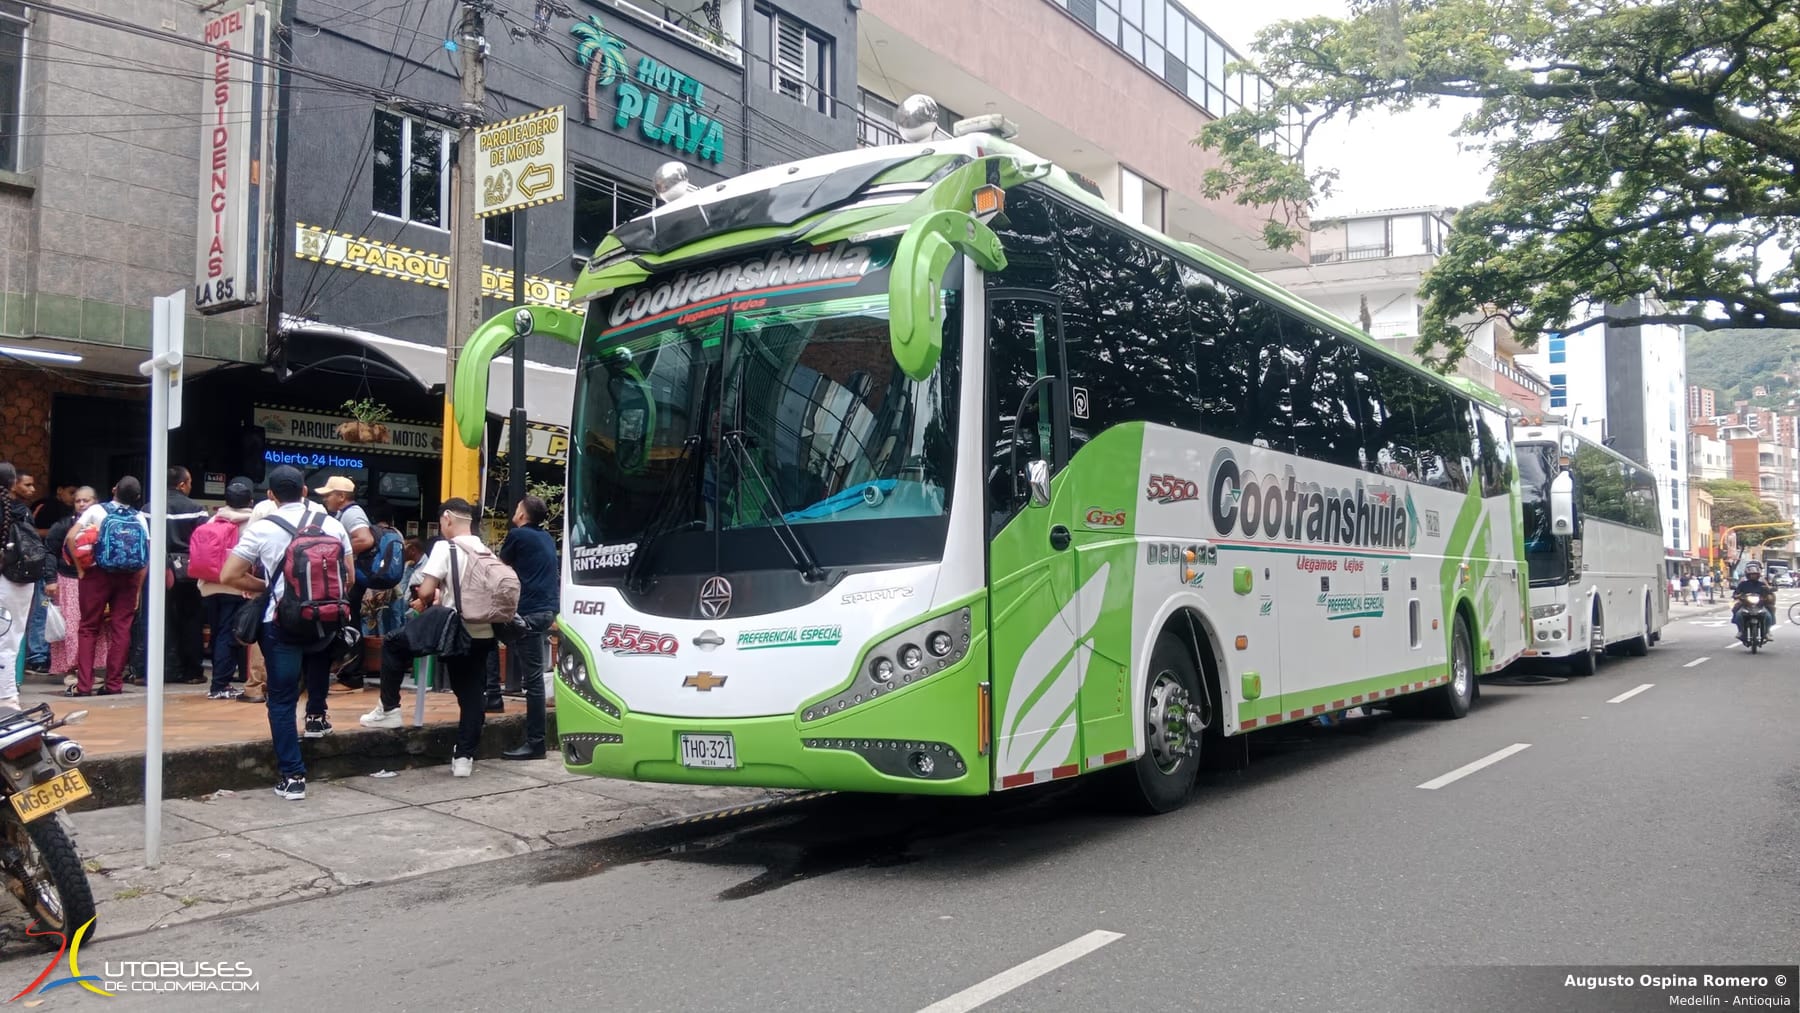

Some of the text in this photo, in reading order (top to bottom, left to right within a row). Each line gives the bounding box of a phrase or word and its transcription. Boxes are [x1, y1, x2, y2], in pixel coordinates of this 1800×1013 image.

[204, 11, 243, 43] HOTEL
[636, 55, 706, 108] HOTEL
[480, 114, 558, 152] PARQUEADERO
[615, 81, 726, 164] PLAYA
[208, 40, 231, 279] RESIDENCIAS
[490, 138, 544, 168] DE MOTOS
[195, 277, 234, 306] LA 85
[608, 241, 872, 327] Cootranshuila
[392, 430, 428, 448] MOTOS
[265, 450, 363, 469] Abierto 24 Horas
[1147, 474, 1199, 501] 5550
[1210, 455, 1407, 549] Cootranshuila
[574, 543, 638, 558] Turismo
[573, 600, 605, 615] AGA
[601, 623, 679, 656] 5550
[737, 624, 842, 645] PREFERENCIAL ESPECIAL
